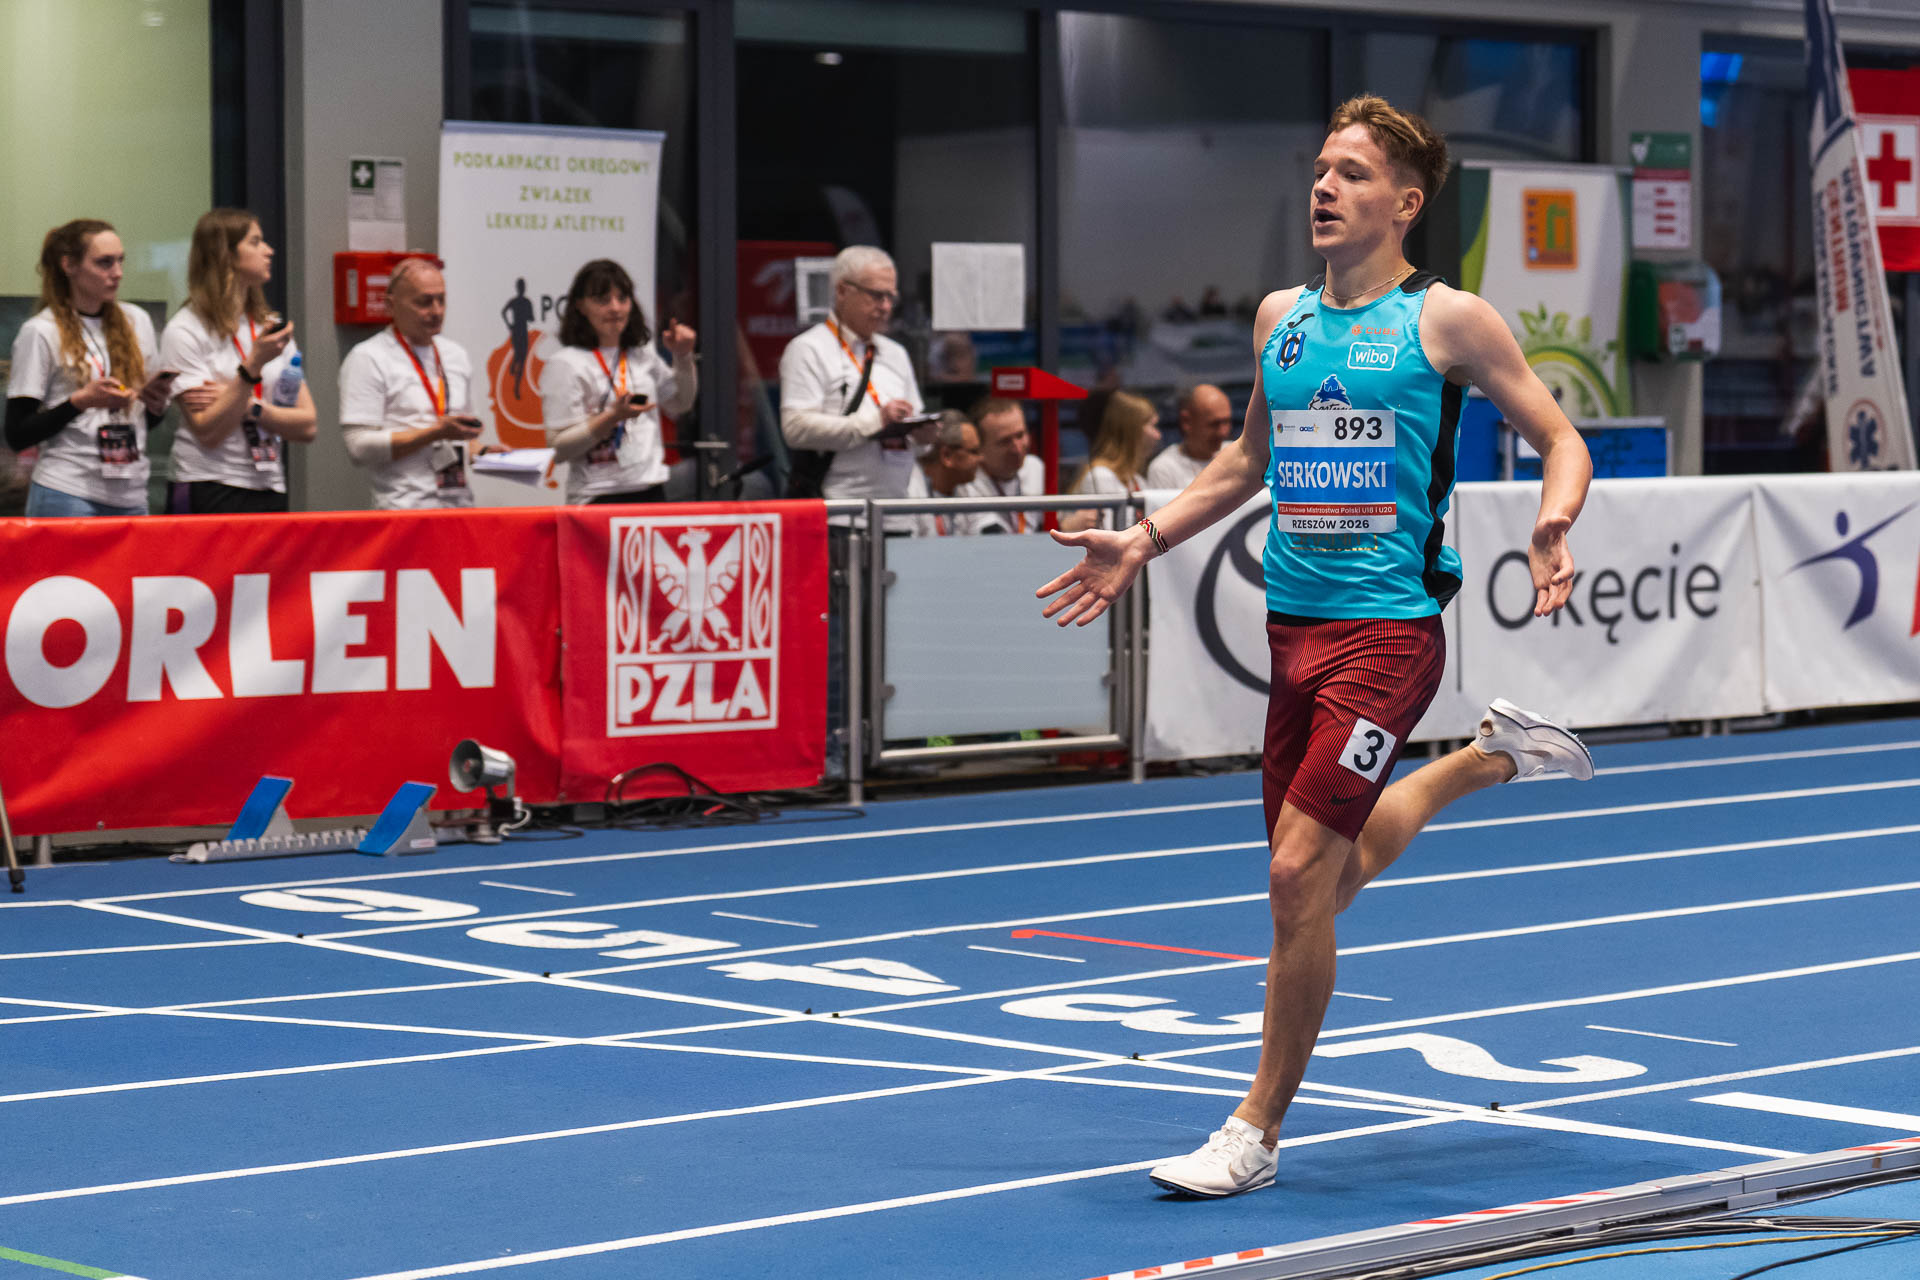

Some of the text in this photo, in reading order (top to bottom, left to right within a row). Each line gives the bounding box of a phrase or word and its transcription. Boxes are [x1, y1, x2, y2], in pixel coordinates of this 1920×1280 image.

[453, 151, 560, 172] PODKARPACKI
[553, 214, 624, 232] ATLETYKI
[1355, 348, 1389, 364] wibo
[1334, 416, 1383, 440] 893
[1277, 461, 1387, 489] SERKOWSKI
[1292, 517, 1370, 529] RZESZÓW 2026
[1306, 506, 1340, 514] Mistrzostwa
[5, 566, 497, 710] ORLEN
[616, 658, 770, 726] PZLA
[1353, 729, 1385, 772] 3
[239, 886, 481, 923] 6
[466, 920, 742, 960] 5
[707, 956, 962, 997] 4
[1000, 993, 1265, 1036] 3
[1311, 1032, 1649, 1084] 2
